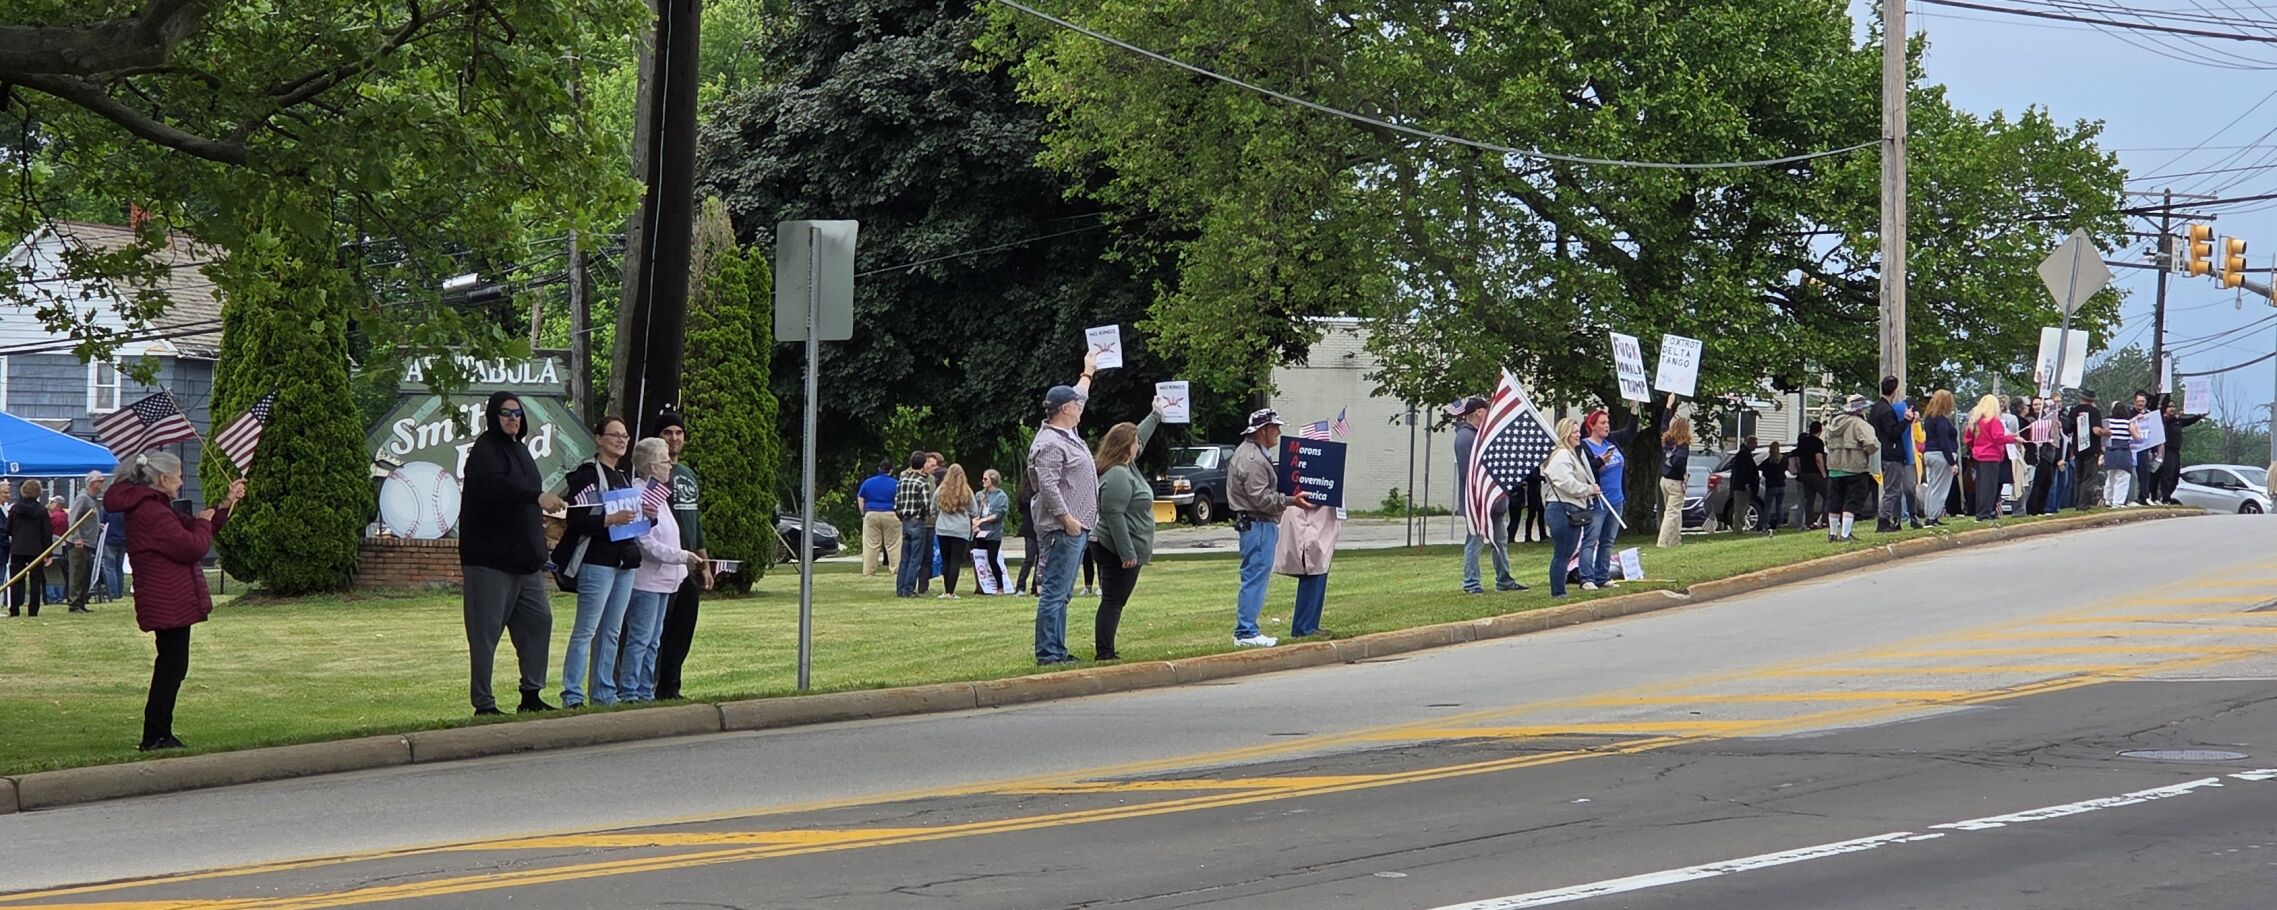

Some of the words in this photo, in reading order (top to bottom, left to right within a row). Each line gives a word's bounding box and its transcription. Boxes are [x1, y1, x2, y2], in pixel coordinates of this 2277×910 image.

[1612, 336, 1639, 360] FUCK
[1664, 335, 1700, 350] FOXTROT
[1662, 345, 1691, 358] DELTA
[405, 355, 559, 384] ATABULA
[1616, 360, 1642, 375] DONALD
[1661, 355, 1690, 368] TANGO
[1620, 378, 1645, 394] TRUMP
[390, 400, 488, 455] Smt
[1288, 440, 1322, 456] Morons
[1290, 455, 1307, 469] Are
[1291, 470, 1335, 490] Governing
[1292, 484, 1328, 501] Arica
